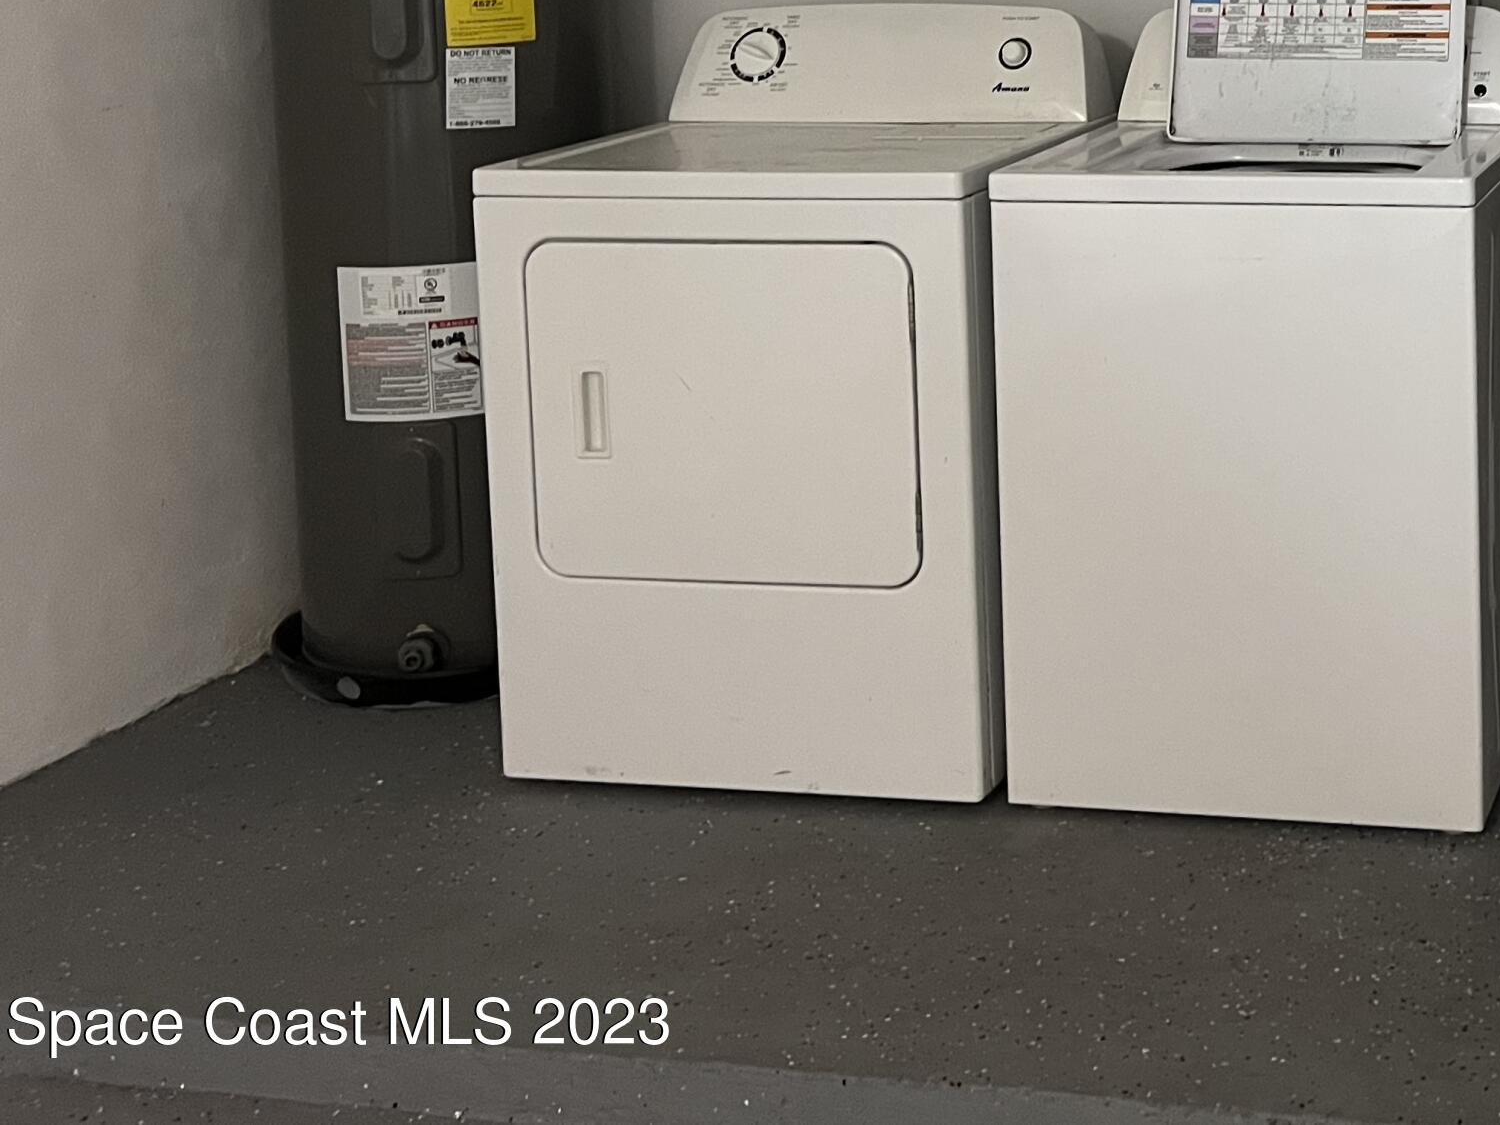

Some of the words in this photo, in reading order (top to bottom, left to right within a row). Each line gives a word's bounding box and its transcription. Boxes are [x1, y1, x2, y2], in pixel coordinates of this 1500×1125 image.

[450, 50, 462, 58] DO
[464, 49, 479, 57] NOT
[481, 49, 512, 57] RETURN
[453, 77, 467, 85] NO
[991, 82, 1030, 93] Amana
